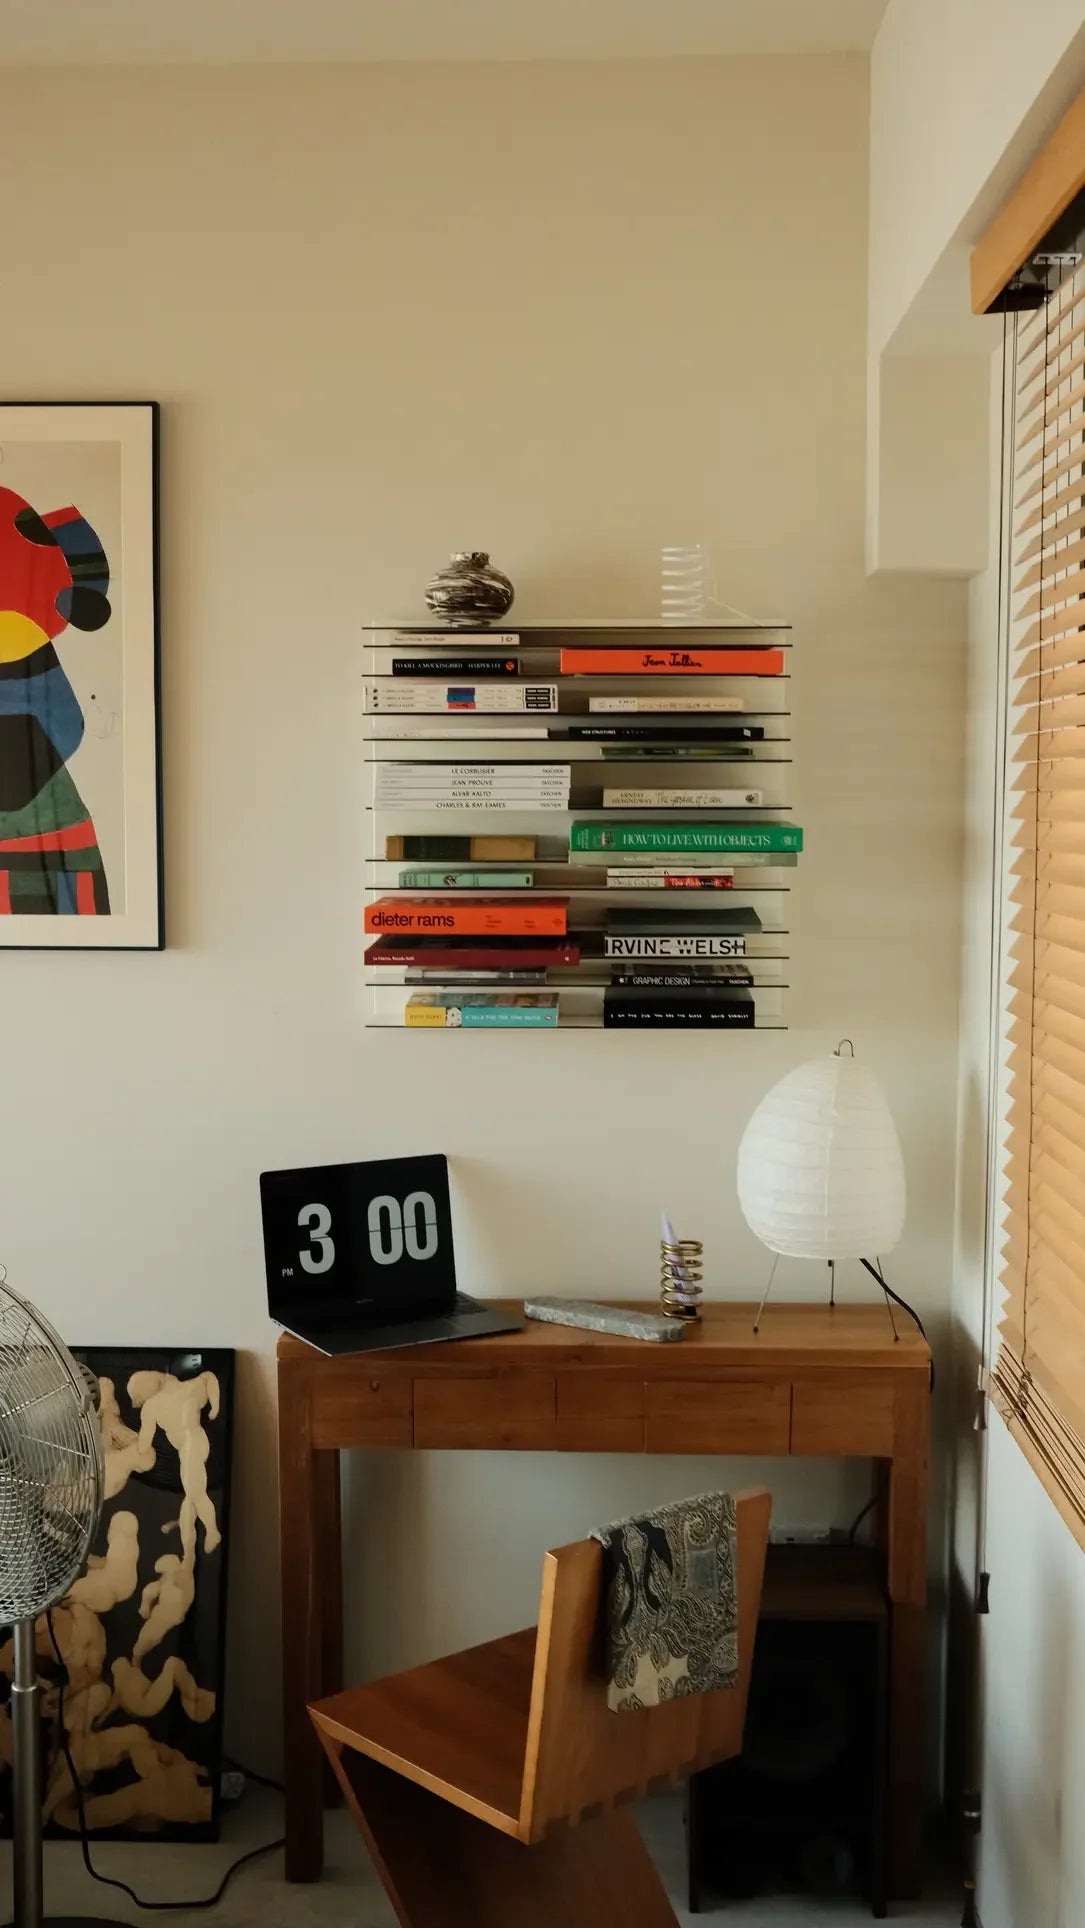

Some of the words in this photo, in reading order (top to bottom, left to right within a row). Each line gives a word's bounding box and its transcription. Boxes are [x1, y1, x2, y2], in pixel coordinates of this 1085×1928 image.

[642, 654, 666, 668] Jean
[623, 834, 648, 845] HOW
[649, 834, 667, 845] TO
[667, 834, 691, 846] LIVE
[690, 834, 722, 846] WITH
[722, 834, 771, 846] OBJECTS
[371, 912, 414, 927] dieter
[417, 914, 455, 927] rams
[605, 939, 671, 955] IRVINE
[677, 938, 746, 955] WELSH
[632, 976, 664, 985] GRAPHIC
[664, 976, 691, 986] DESIGN
[298, 1203, 335, 1274] 3
[367, 1191, 438, 1265] 00
[282, 1268, 294, 1277] PM
